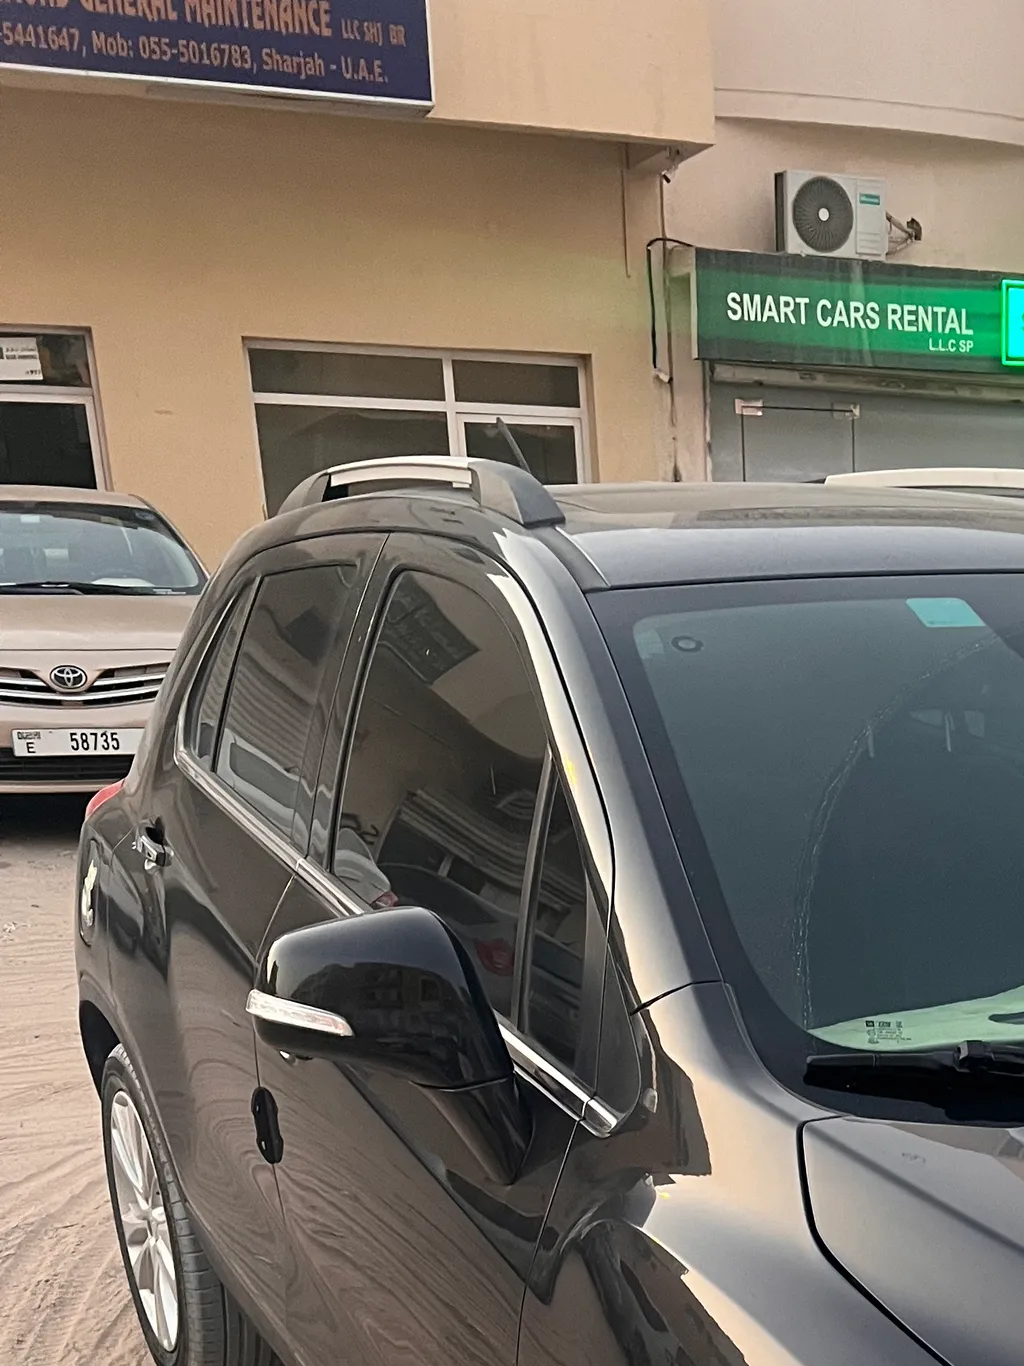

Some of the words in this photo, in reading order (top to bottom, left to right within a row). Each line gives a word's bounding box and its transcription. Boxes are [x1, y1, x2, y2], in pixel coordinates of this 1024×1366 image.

[185, 0, 332, 36] MAINTENANCE
[92, 30, 134, 58] Mob:
[139, 35, 257, 74] 055-5016783,
[262, 48, 325, 80] Sharjah
[341, 55, 388, 83] U.A.E.
[727, 292, 810, 325] SMART
[816, 299, 880, 329] CARS
[887, 303, 974, 335] RENTAL
[928, 337, 956, 352] L.L.C
[959, 340, 974, 353] SP
[26, 742, 36, 753] E
[70, 731, 120, 751] 58735
